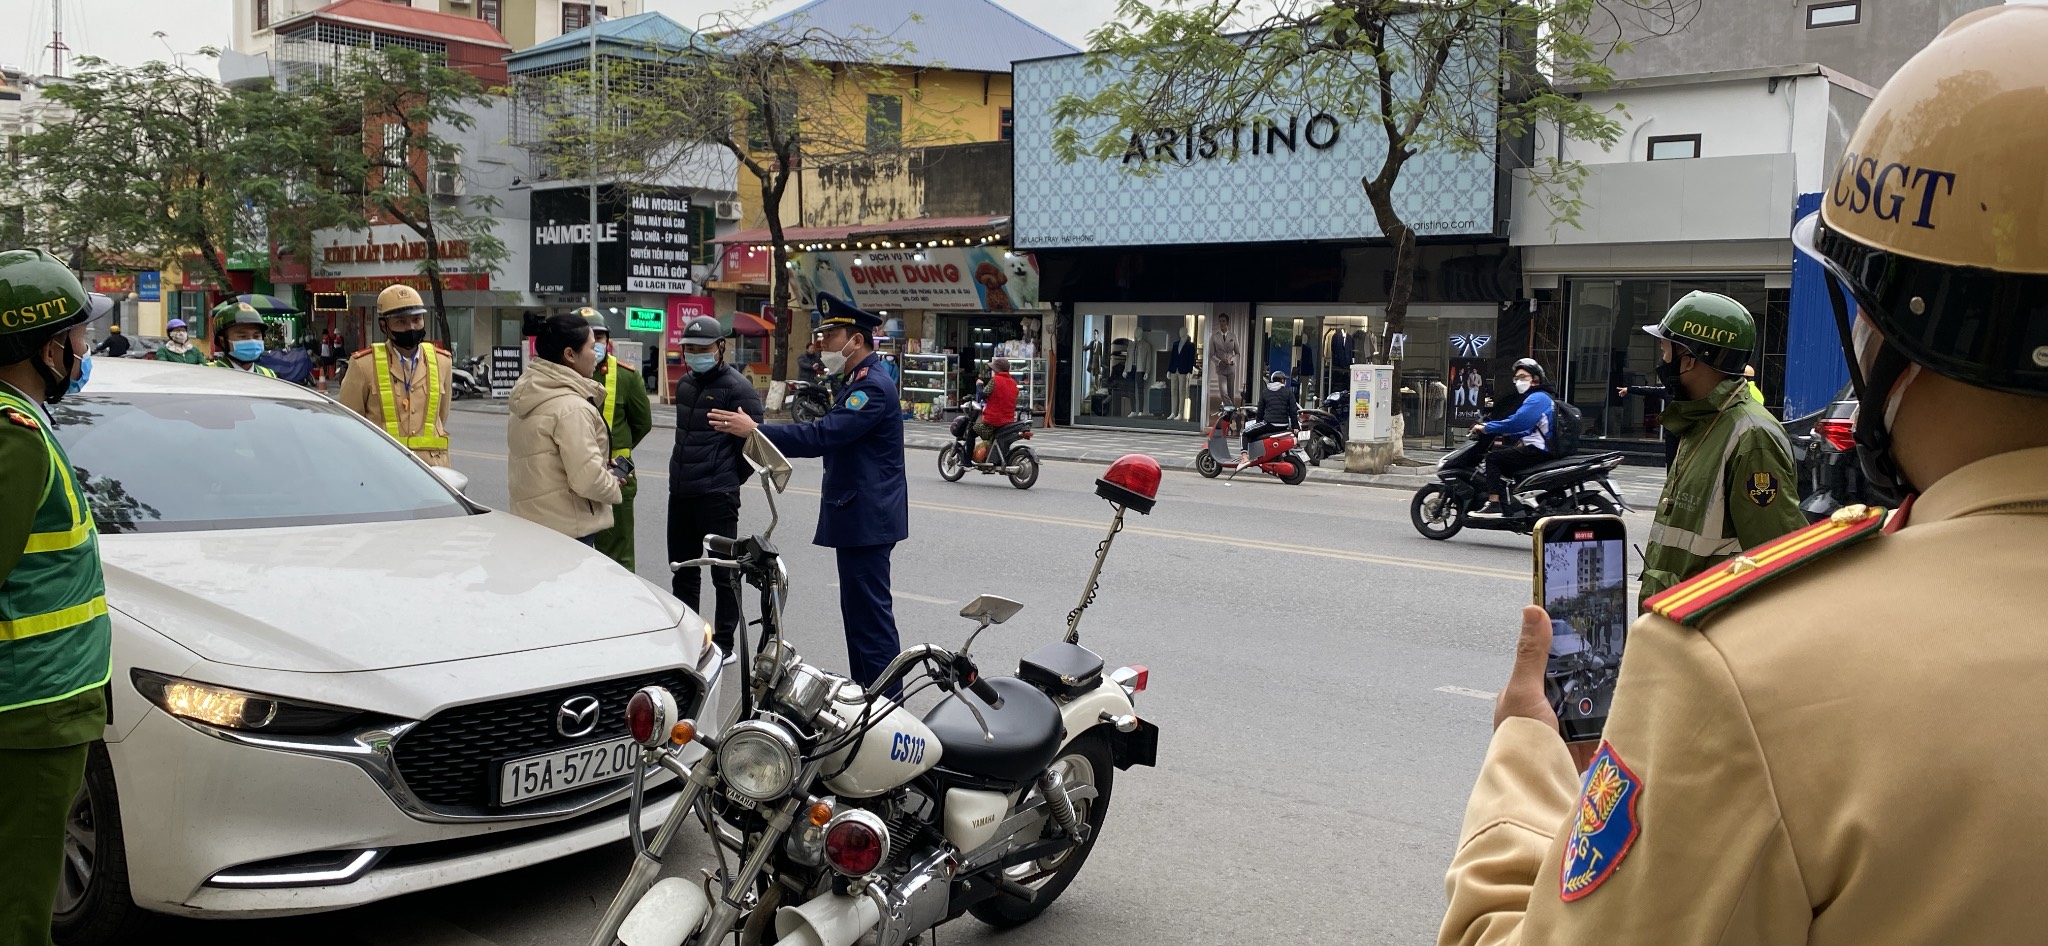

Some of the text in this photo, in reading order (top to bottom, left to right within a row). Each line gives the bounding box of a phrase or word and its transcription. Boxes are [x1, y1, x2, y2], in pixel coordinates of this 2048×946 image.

[1122, 113, 1341, 164] ARISTINO
[1833, 152, 1956, 229] CSGT
[632, 193, 688, 212] HẢI MOBILE
[634, 215, 685, 228] MUA MÁY GIÁ CAO
[536, 219, 618, 245] HẢIMOBLE
[631, 228, 643, 241] SỬA
[644, 230, 660, 242] CHỮA
[665, 231, 673, 243] ÉP
[674, 231, 688, 244] KÍNH
[354, 231, 381, 263] MẮT
[381, 234, 427, 261] HOÀNG
[869, 253, 890, 263] DỊCH
[892, 253, 902, 262] VỤ
[633, 263, 688, 278] BÁN TRẢ GÓP
[850, 263, 961, 288] ĐỊNH DUNG
[634, 280, 685, 290] 40 LẠCH TRAY
[2, 297, 67, 327] CSTT
[638, 311, 655, 320] THAY
[890, 731, 926, 765] CS113
[511, 740, 641, 798] 15A-572.00
[727, 788, 756, 808] YAMAHA
[972, 813, 995, 829] YAMAHA
